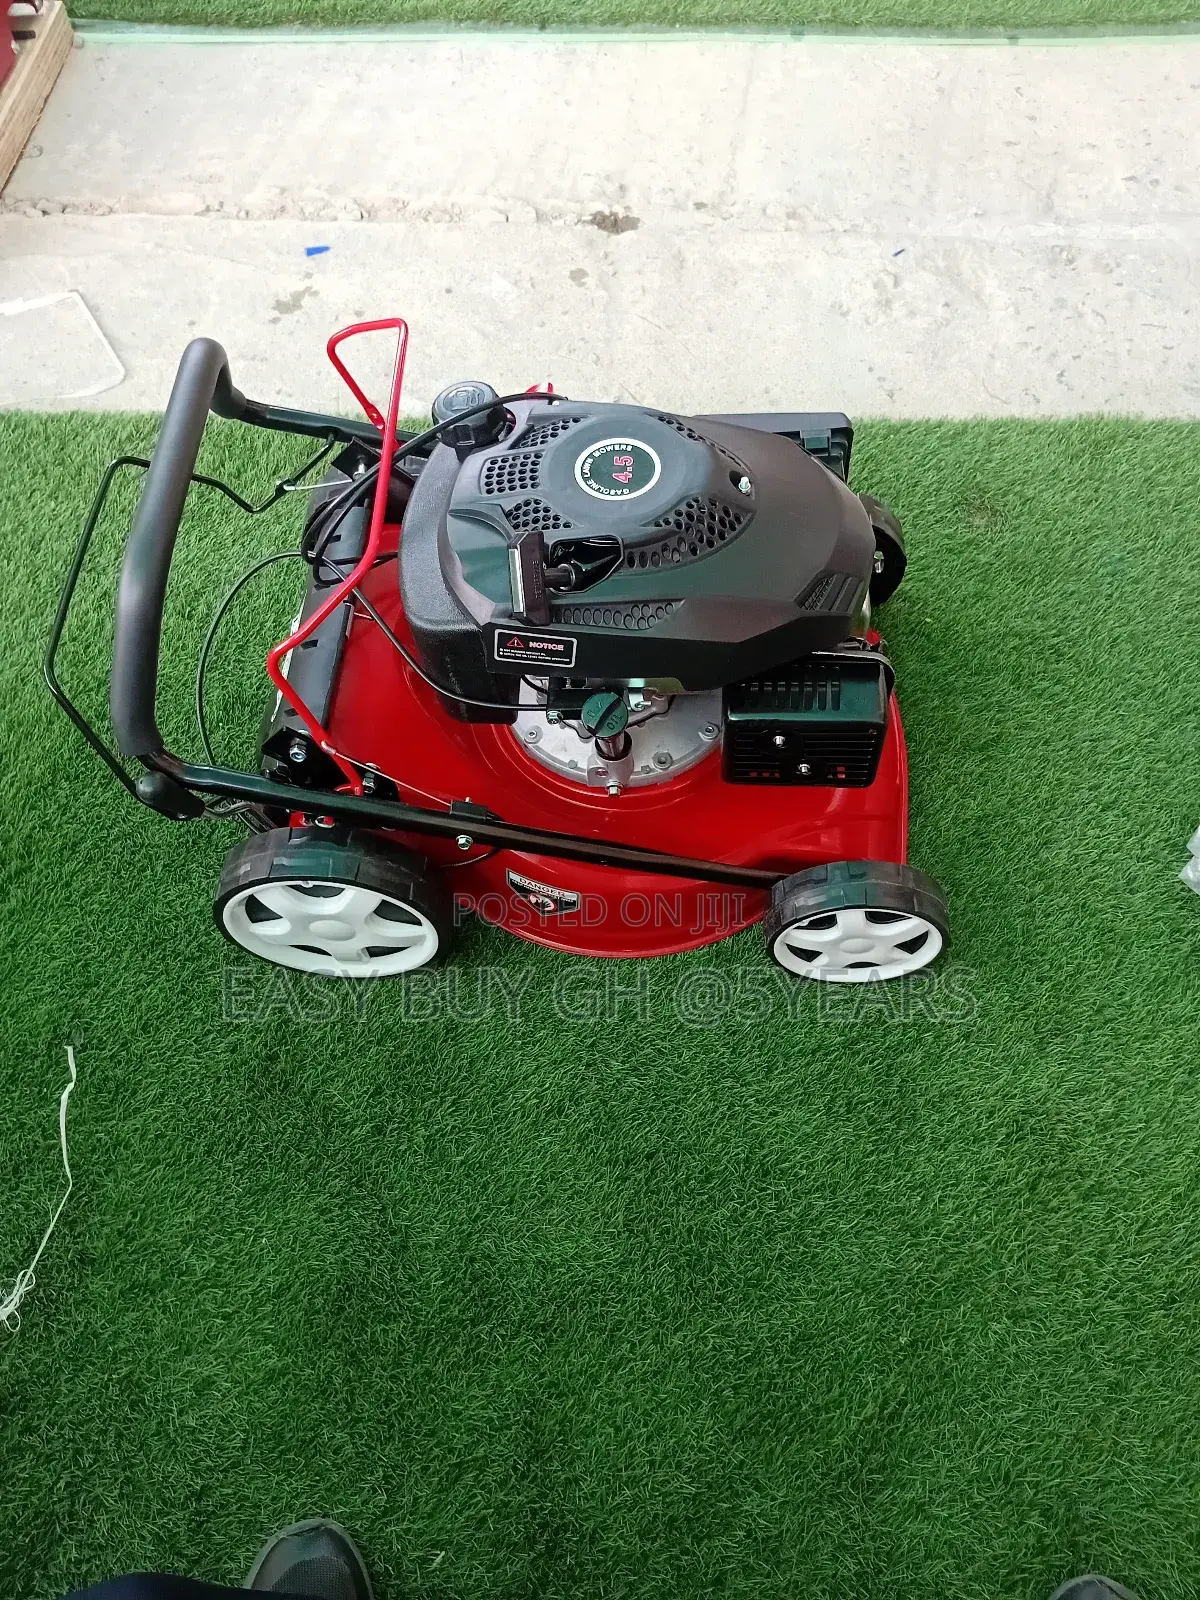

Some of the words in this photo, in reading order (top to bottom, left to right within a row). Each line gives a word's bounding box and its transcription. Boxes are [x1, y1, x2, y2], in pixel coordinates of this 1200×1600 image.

[592, 444, 633, 458] MOWERS
[582, 457, 594, 478] LAWN
[612, 455, 634, 483] 4.5
[586, 478, 630, 496] GASOLINE
[528, 641, 565, 651] NOTICE
[606, 714, 623, 730] OIL
[519, 877, 566, 897] DANGER
